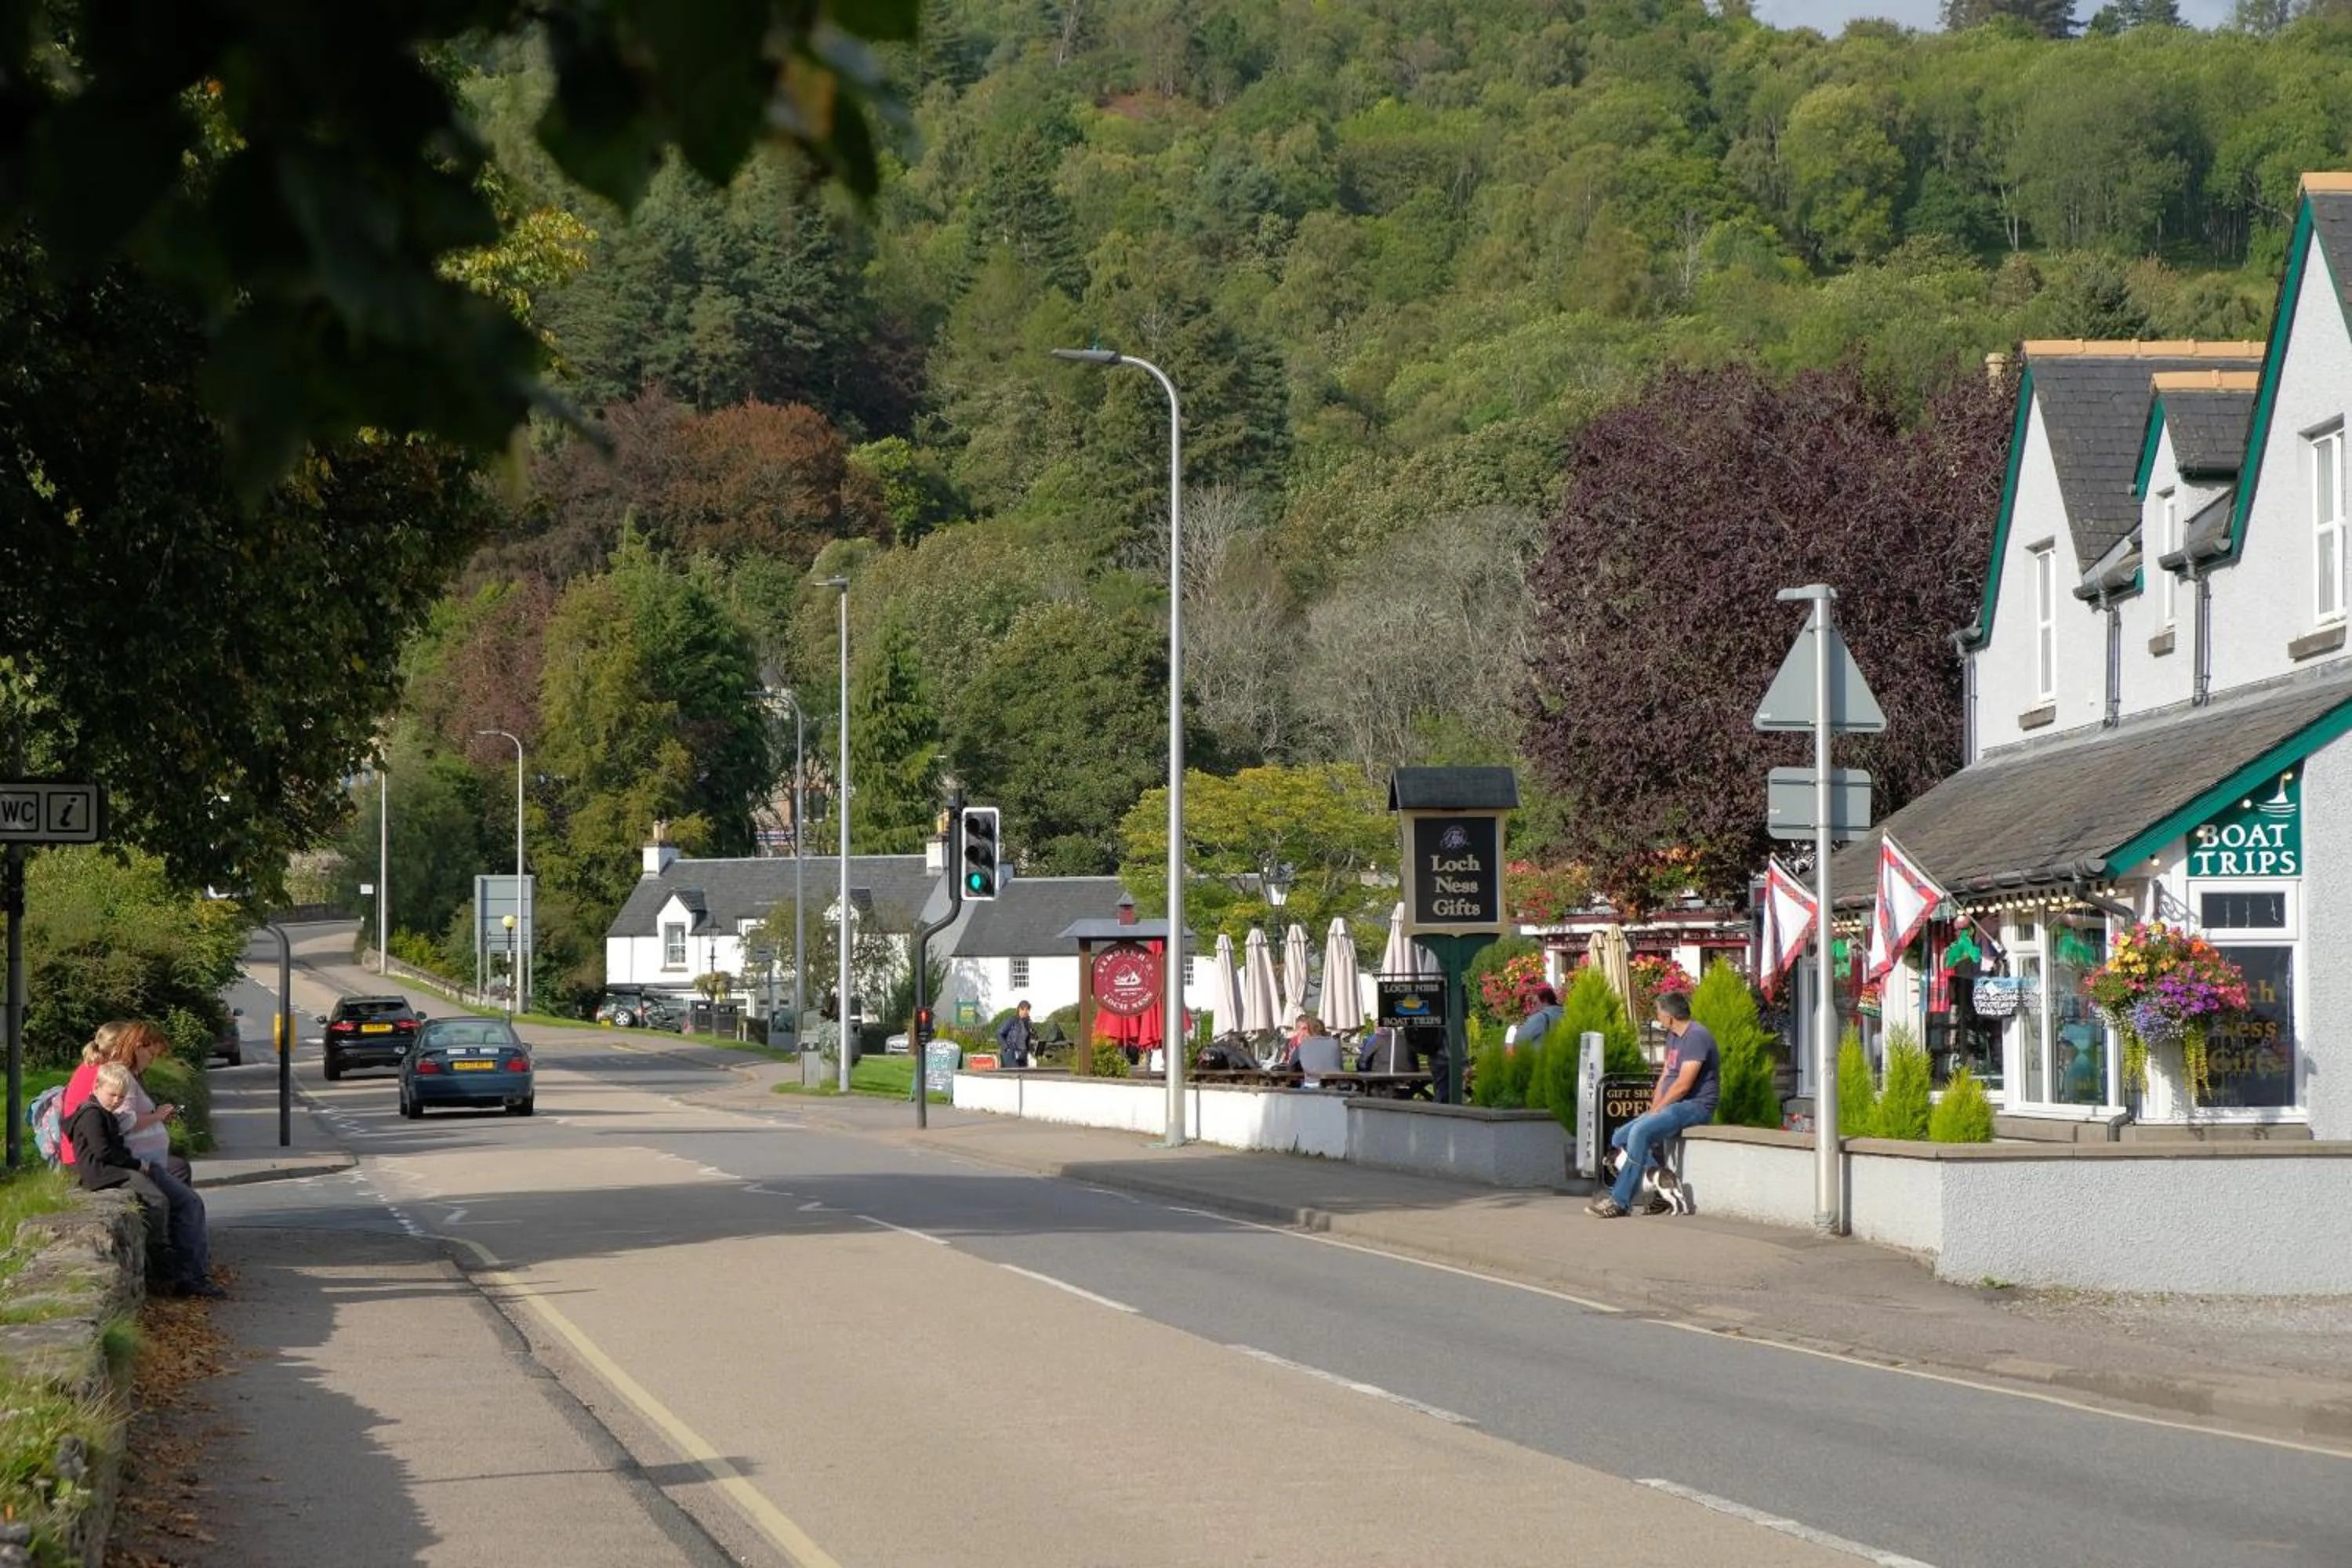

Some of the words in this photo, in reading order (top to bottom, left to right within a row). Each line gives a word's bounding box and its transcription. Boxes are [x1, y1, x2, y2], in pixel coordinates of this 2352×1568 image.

[1, 800, 34, 822] WC
[2197, 823, 2290, 848] BOAT
[1429, 854, 1481, 873] Loch
[2193, 851, 2296, 876] TRIPS
[1434, 876, 1479, 894] Ness
[1432, 898, 1481, 916] Gifts
[1383, 983, 1412, 993] LOCH
[1102, 993, 1129, 1011] LOCH
[1381, 1017, 1410, 1026] BOAT
[2208, 1047, 2282, 1075] Gifts
[1606, 1089, 1631, 1098] GIFT
[1633, 1089, 1656, 1098] SHO
